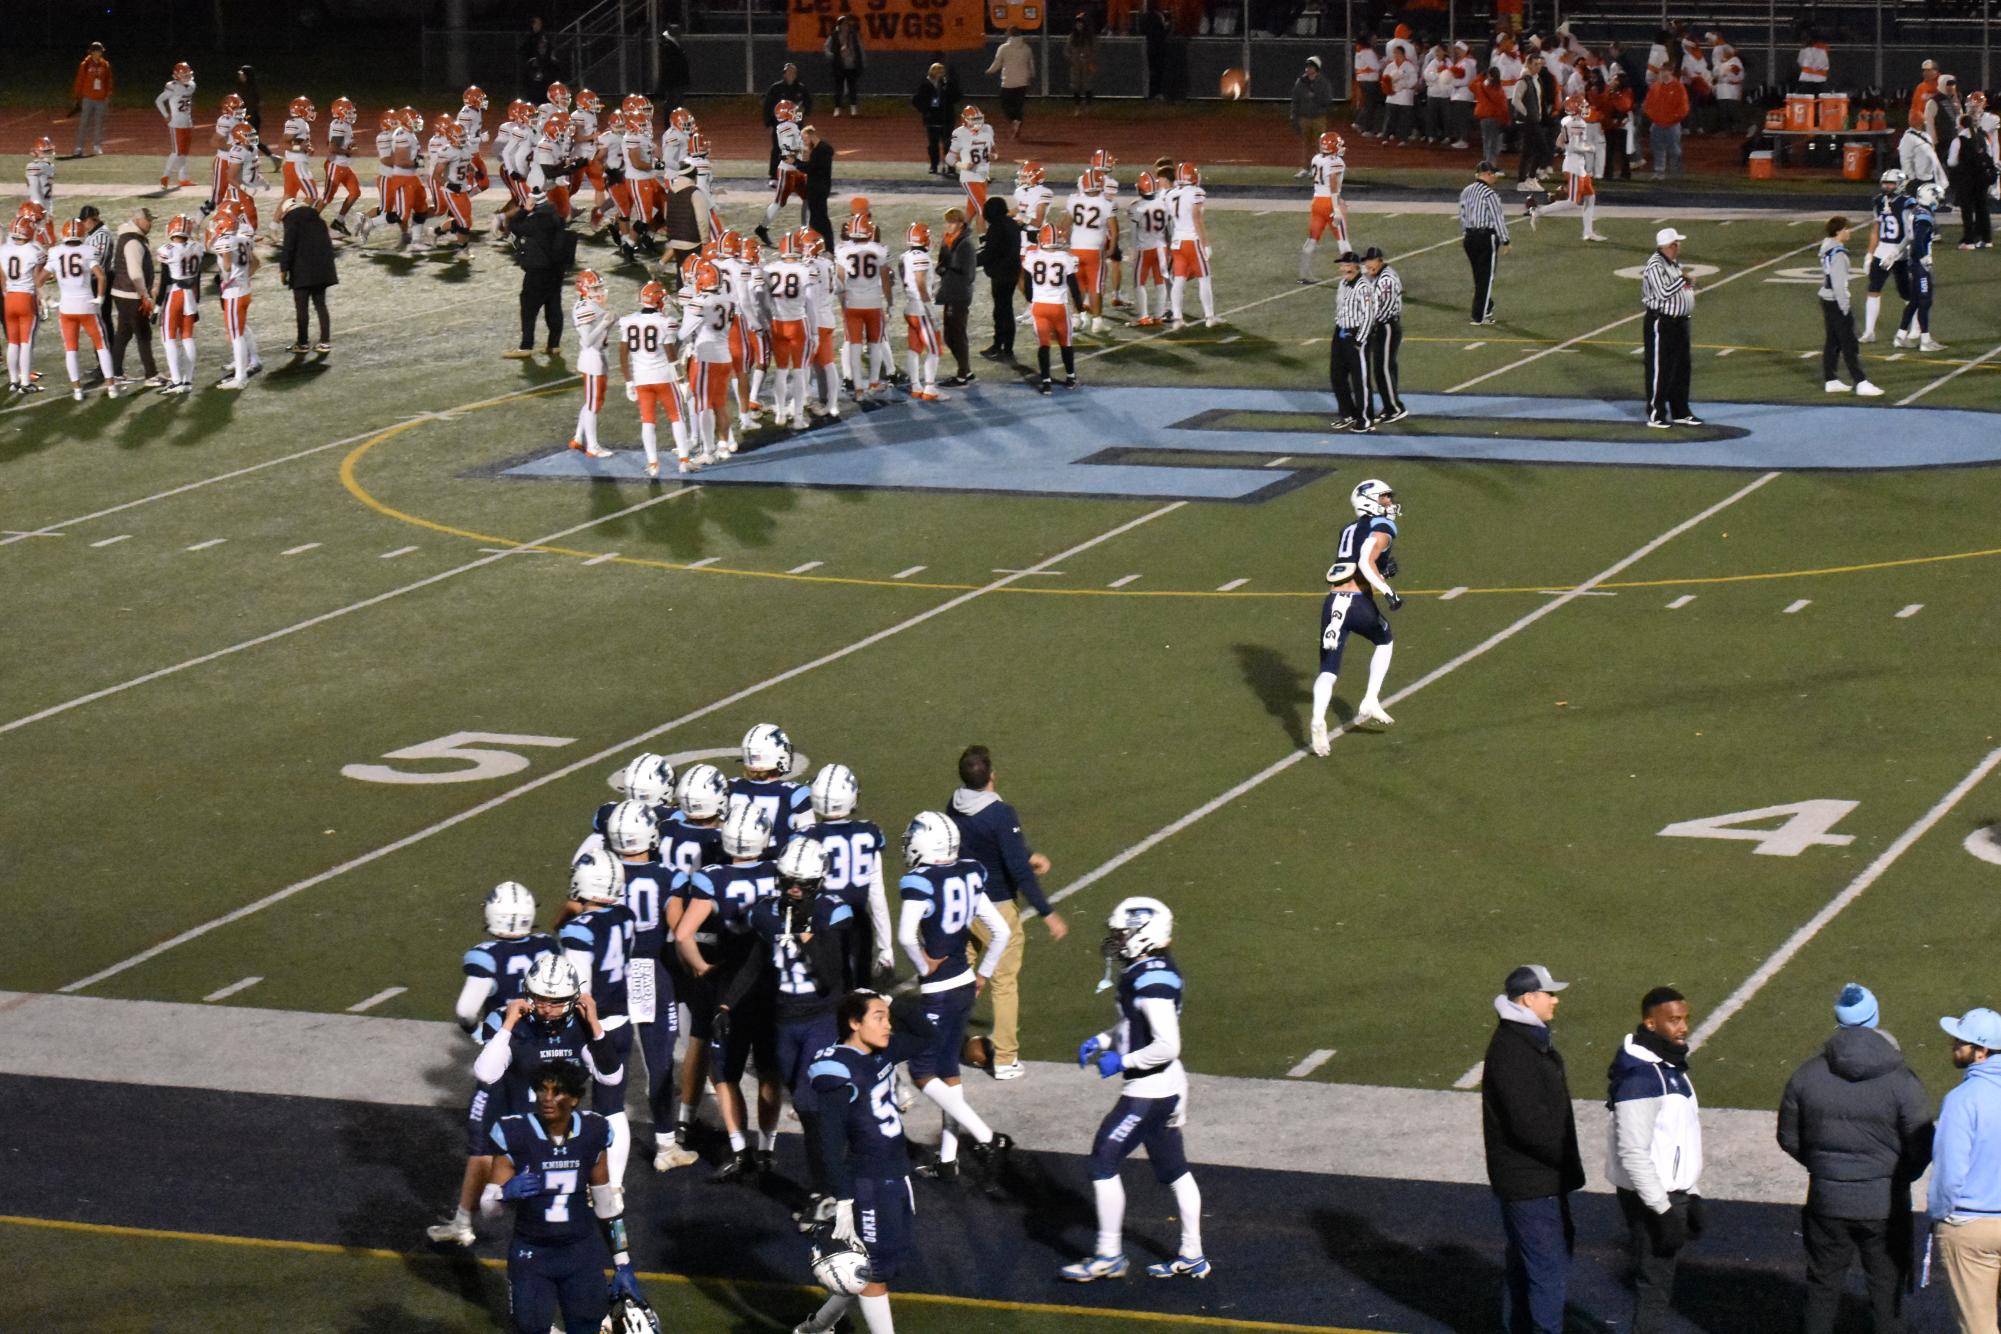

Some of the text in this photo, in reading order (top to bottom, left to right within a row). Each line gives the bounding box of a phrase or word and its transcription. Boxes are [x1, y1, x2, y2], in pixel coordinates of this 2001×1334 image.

[817, 12, 945, 40] DWGS
[1073, 203, 1101, 230] 62
[1144, 208, 1166, 232] 19
[8, 255, 20, 281] 0
[59, 253, 83, 279] 16
[181, 254, 199, 277] 10
[847, 253, 877, 279] 36
[1033, 260, 1064, 287] 83
[769, 271, 800, 299] 28
[627, 324, 658, 353] 88
[340, 730, 579, 784] 5
[1656, 798, 1861, 857] 4
[823, 832, 877, 891] 36
[941, 871, 984, 935] 86
[600, 919, 634, 984] 4
[540, 1048, 574, 1059] KNIGHTS
[541, 1159, 581, 1170] KNIGHTS
[544, 1169, 579, 1223] 7
[861, 1208, 878, 1244] TEMPO
